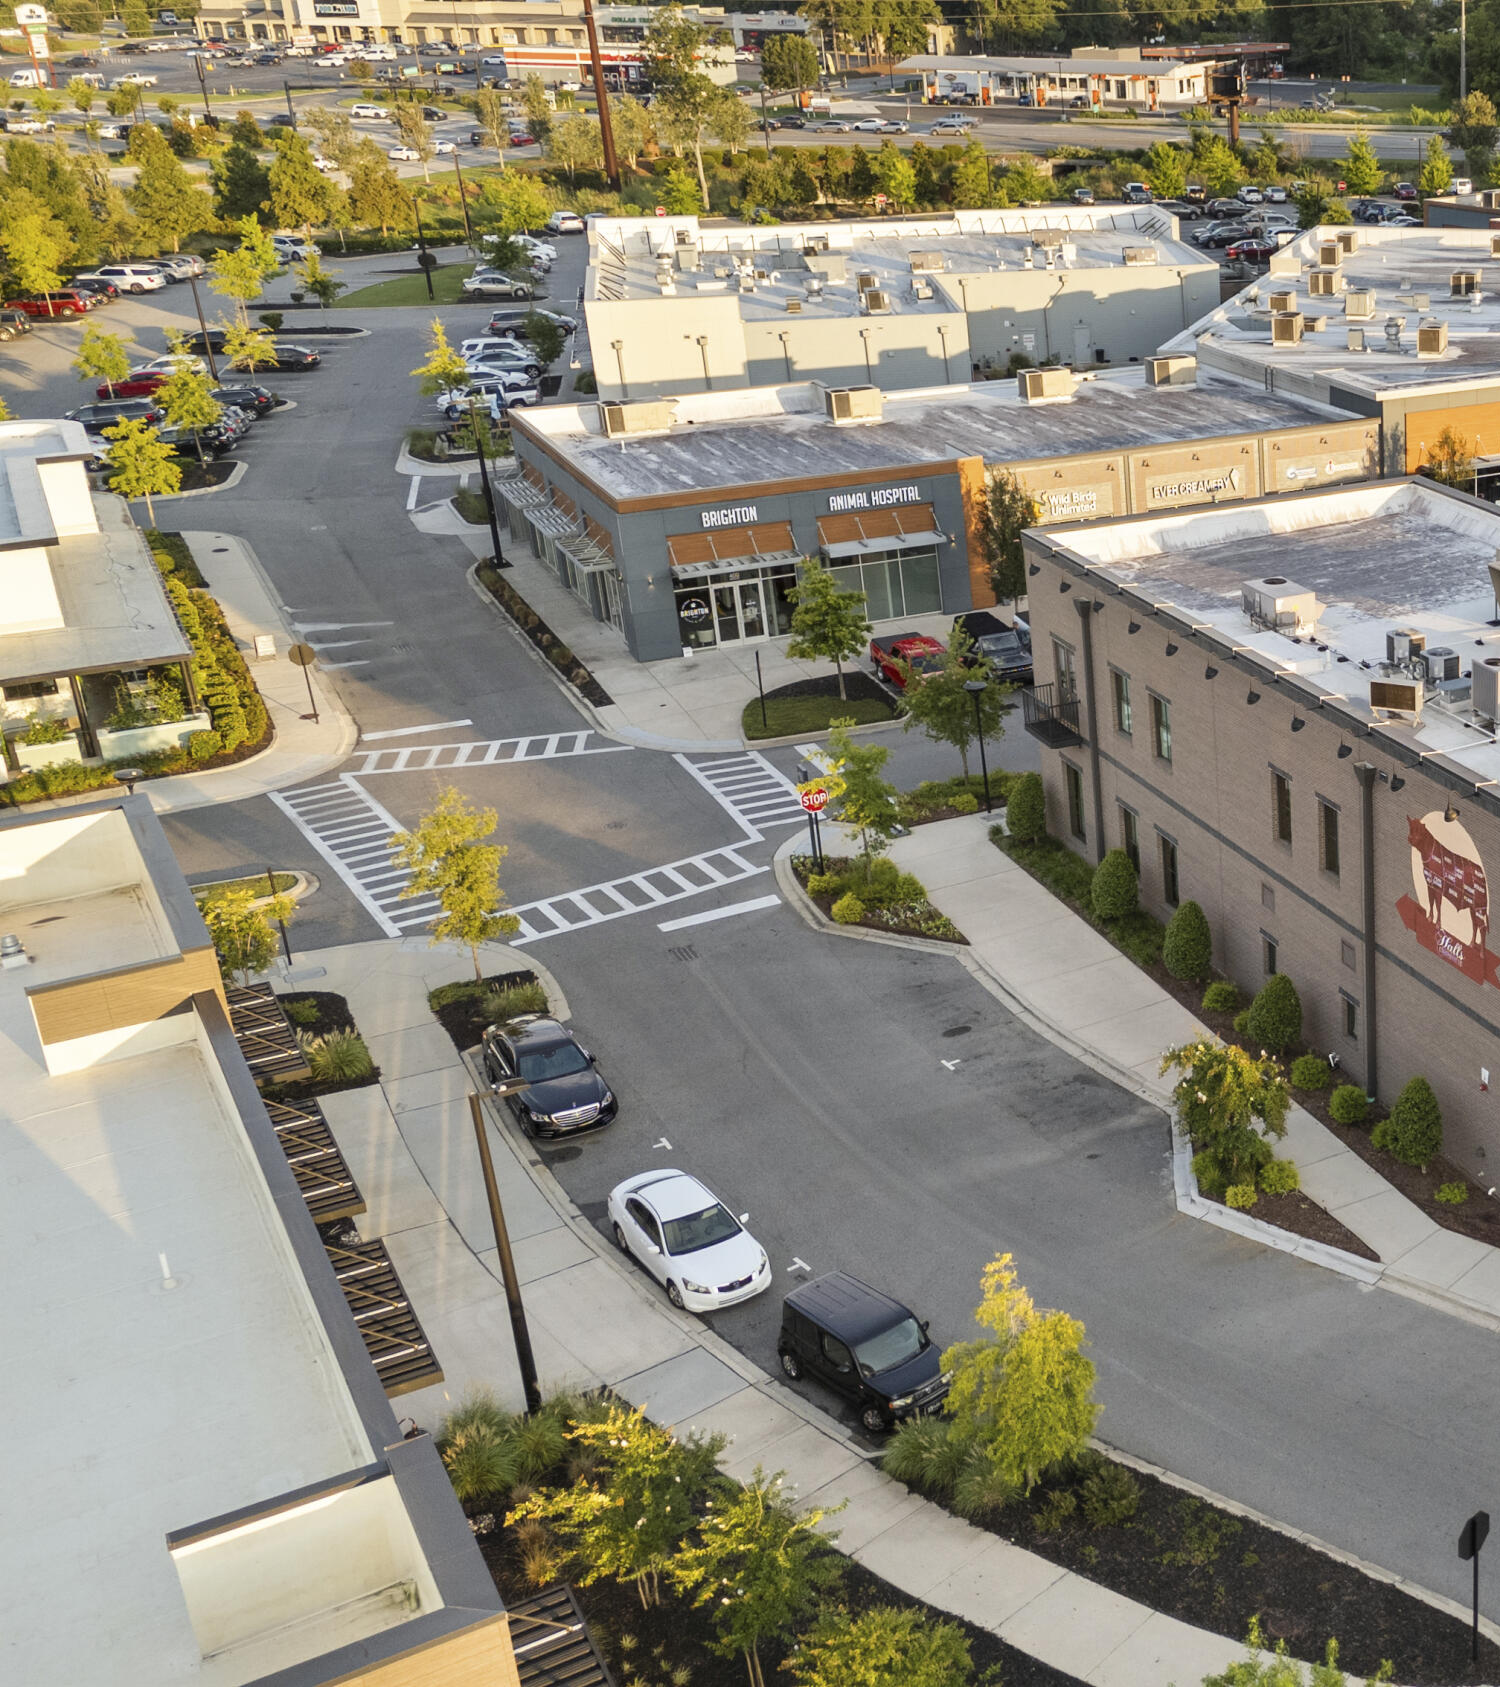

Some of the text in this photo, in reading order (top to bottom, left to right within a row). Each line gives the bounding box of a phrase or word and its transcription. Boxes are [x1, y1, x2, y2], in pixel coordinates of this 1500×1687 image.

[1153, 477, 1230, 499] EVER CREAMERY
[829, 486, 922, 512] ANIMAL HOSPITAL
[1049, 490, 1097, 506] Wild Birds
[701, 506, 758, 528] BRIGHTON
[1051, 501, 1097, 516] Unlimited
[803, 792, 827, 806] STOP
